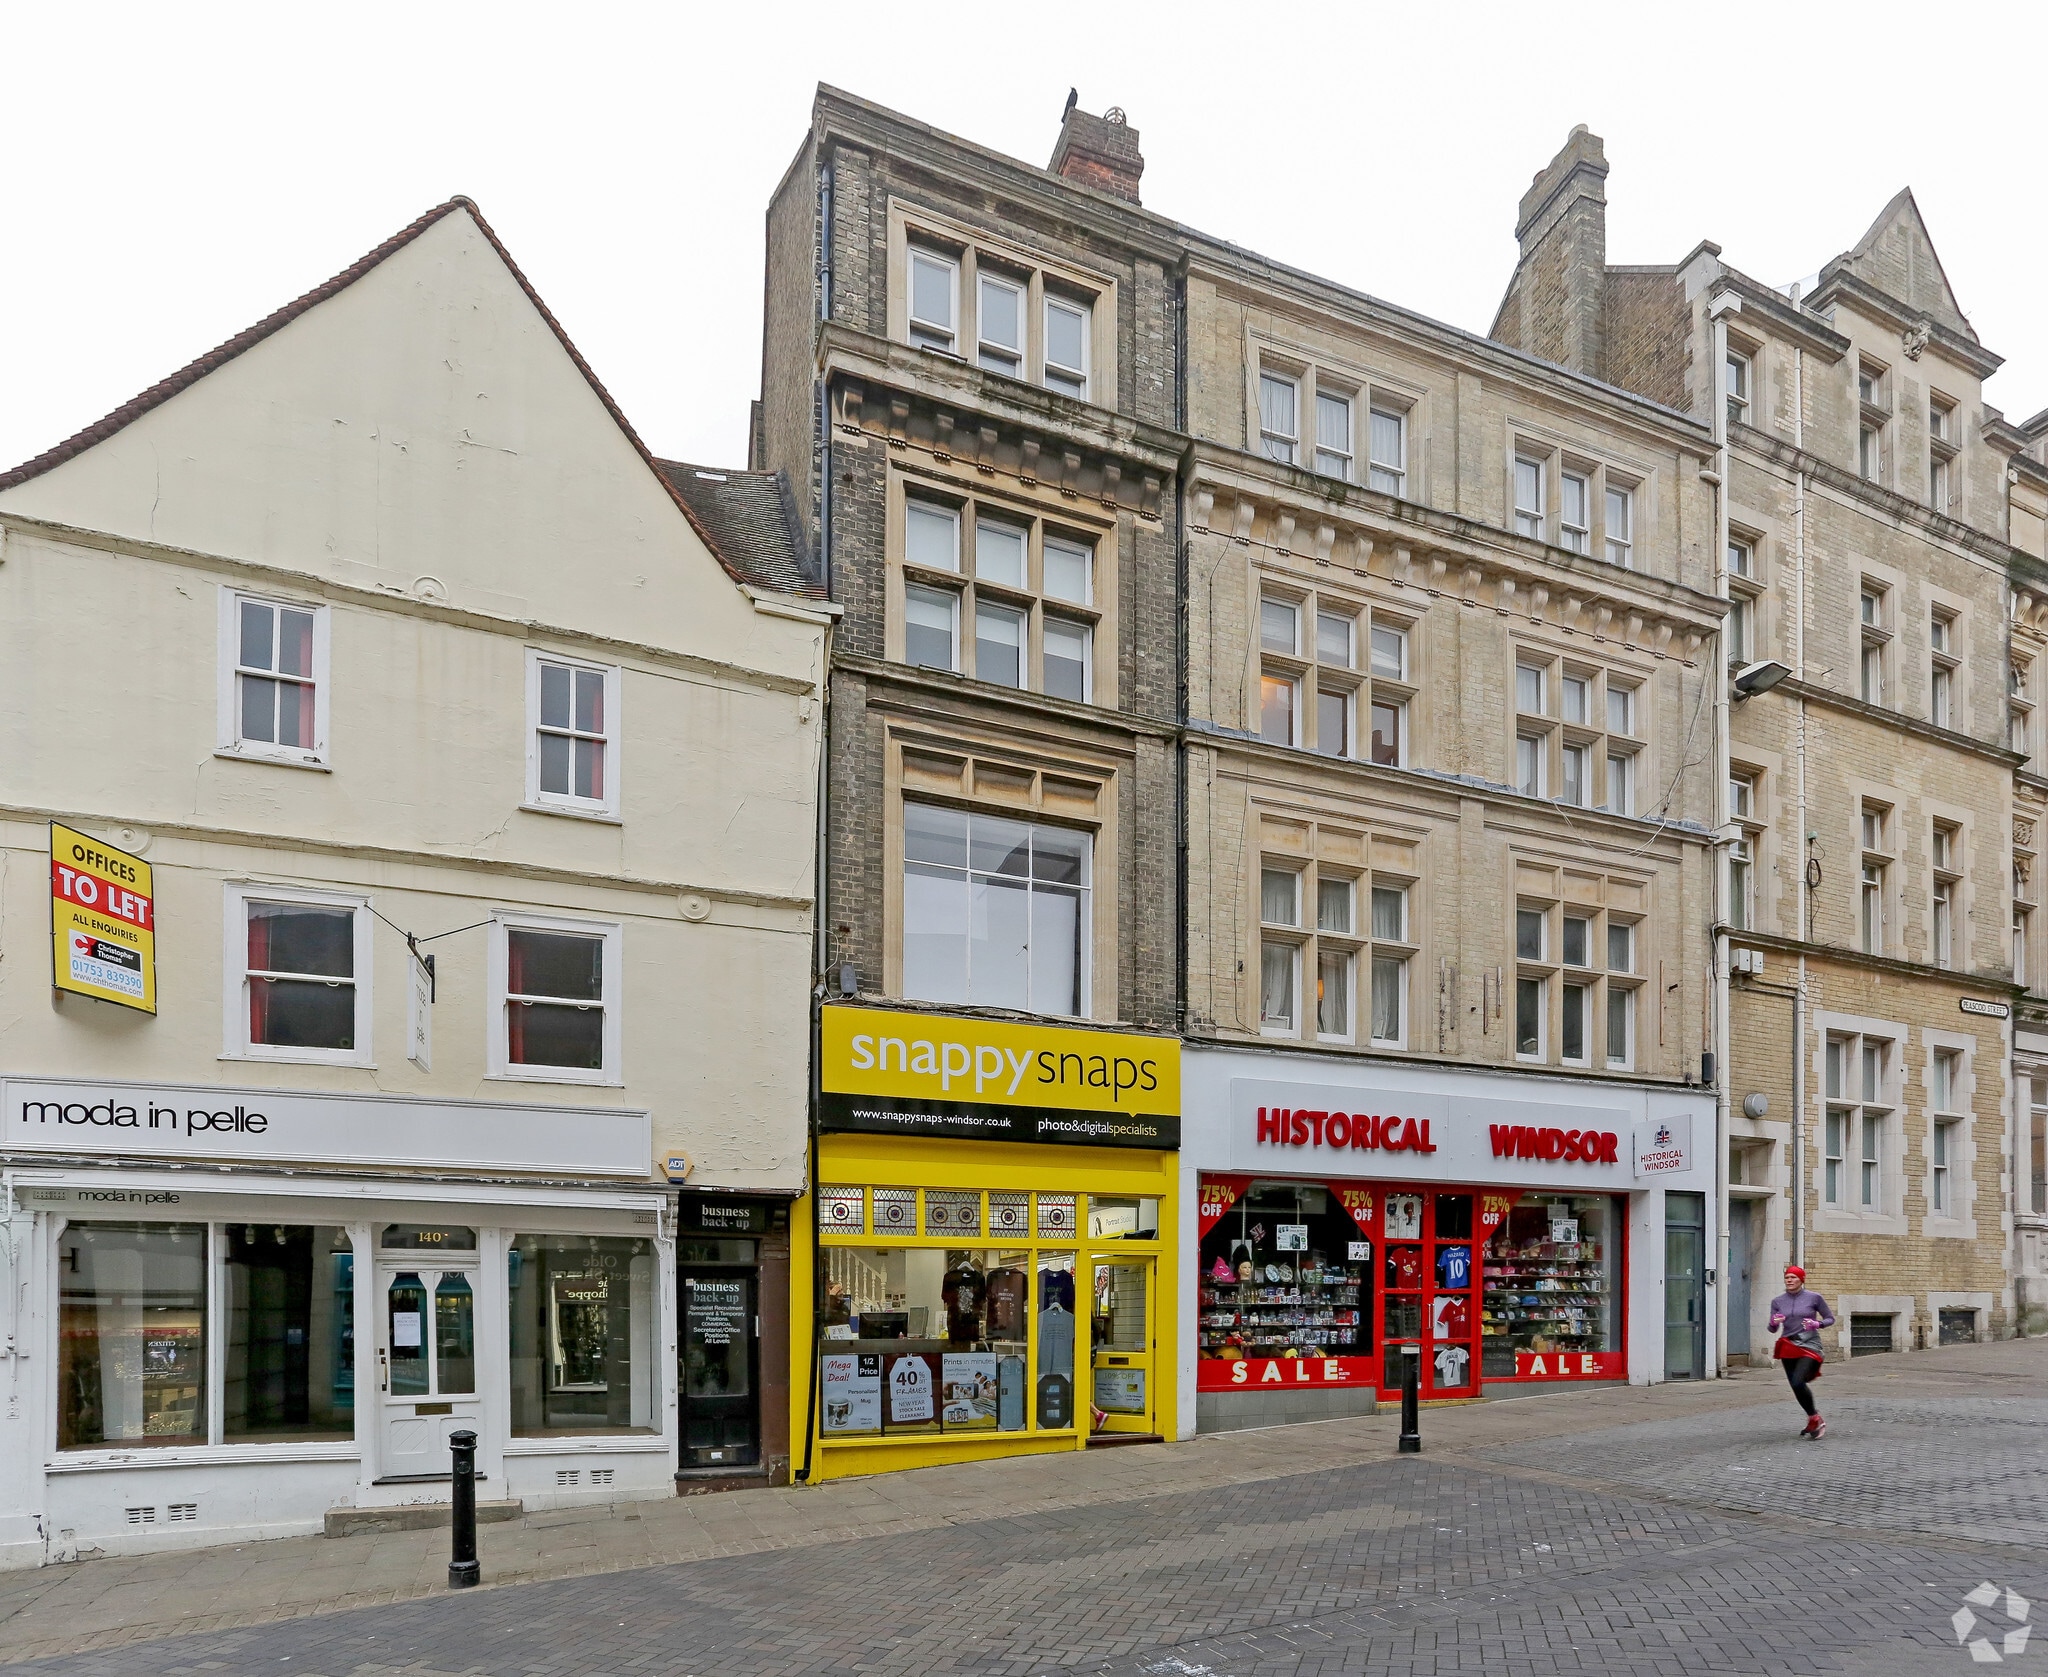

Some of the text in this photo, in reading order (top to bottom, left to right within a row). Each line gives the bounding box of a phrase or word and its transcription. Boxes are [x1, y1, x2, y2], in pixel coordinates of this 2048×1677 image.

[72, 844, 135, 883] OFFICES
[58, 866, 148, 924] TO LET
[73, 913, 138, 942] ALL ENQUIRIES
[97, 949, 122, 964] Thomas
[98, 943, 134, 961] Christopher
[72, 959, 103, 978] 01753
[106, 969, 142, 989] 839390
[1963, 1000, 2006, 1016] PEASCOD STREET
[22, 1099, 268, 1137] moda in pelle
[852, 1107, 1011, 1128] www.snappysnaps-windsor.co.uk
[1257, 1106, 1437, 1153] HISTORICAL
[1489, 1123, 1618, 1164] WINDSOR
[669, 1160, 684, 1168] ADT
[1640, 1150, 1683, 1163] HISTORICAL
[1644, 1160, 1680, 1171] WINDSOR
[78, 1190, 180, 1205] moda in pelle
[1202, 1185, 1235, 1203] 75%
[1343, 1190, 1373, 1208] 75%
[702, 1204, 750, 1217] business
[1201, 1203, 1222, 1217] OFF
[1483, 1196, 1510, 1213] 75%
[1354, 1208, 1373, 1221] OFF
[1482, 1212, 1500, 1225] OFF
[419, 1232, 442, 1242] 140
[1450, 1259, 1464, 1279] 10
[693, 1281, 740, 1292] business
[827, 1360, 852, 1371] Mega
[1231, 1359, 1339, 1384] SALE
[1448, 1360, 1456, 1378] 7
[1515, 1354, 1594, 1375] ALE
[827, 1373, 850, 1382] Deal!
[896, 1371, 917, 1386] 40
[1121, 1372, 1136, 1380] OFF
[896, 1387, 927, 1395] FRAMES
